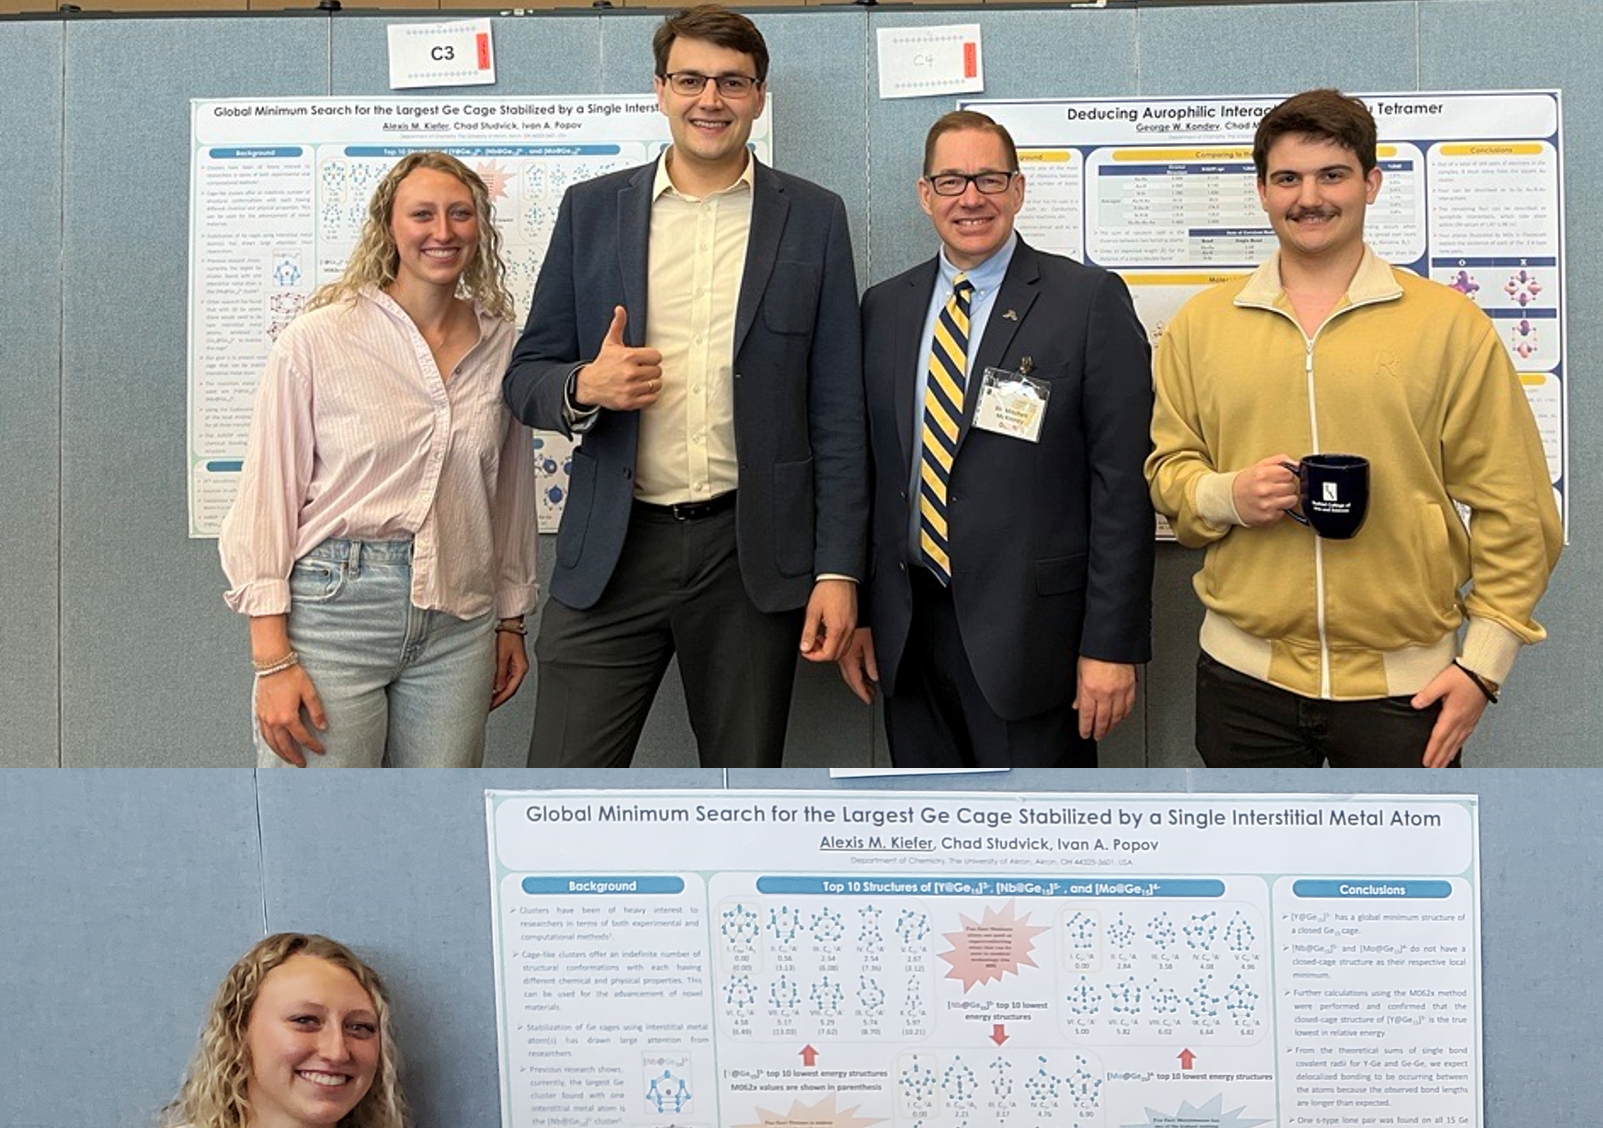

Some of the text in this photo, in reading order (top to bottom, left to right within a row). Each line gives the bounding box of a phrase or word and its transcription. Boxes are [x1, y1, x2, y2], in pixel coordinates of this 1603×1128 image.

[430, 45, 455, 61] C3
[213, 103, 660, 118] Global Minimum Search for the Largest Ge Cage Stabilized by a Single Interst
[1067, 102, 1444, 122] Deducing Aurophilic Interac Tetramer
[526, 805, 1442, 829] Global Minimum Search for the Largest Ge Cage Stabilized by a Single Interstitial Metal Atom
[820, 836, 1160, 853] Alexis M. Kiefer, Chad Studvick, Ivan A. Popov
[568, 879, 637, 894] Background
[1339, 884, 1406, 896] Conclusions
[766, 1070, 781, 1078] top
[782, 1069, 792, 1078] 10
[792, 1069, 820, 1077] lowest
[820, 1071, 848, 1079] energy
